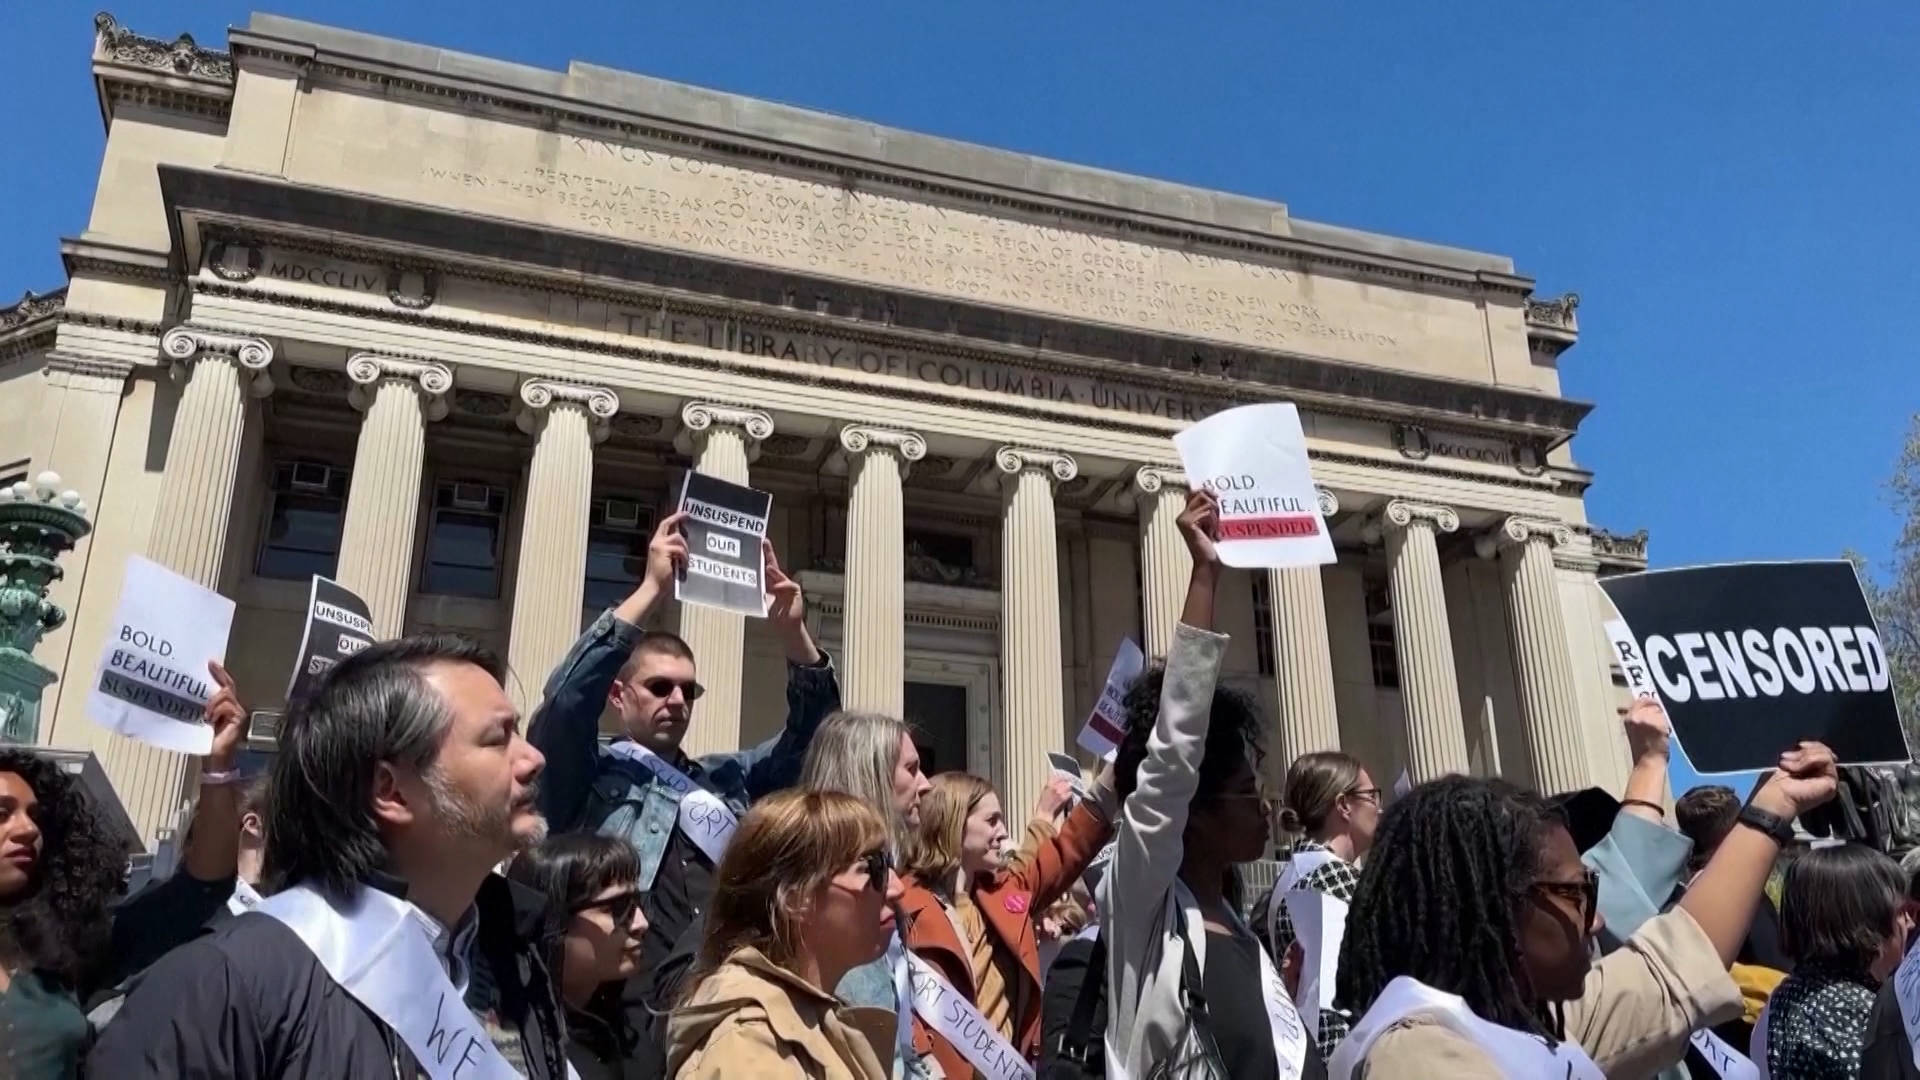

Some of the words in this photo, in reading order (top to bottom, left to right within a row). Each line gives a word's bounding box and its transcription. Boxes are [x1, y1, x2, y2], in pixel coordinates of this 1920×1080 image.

[269, 260, 378, 292] MDCCLIV
[1081, 250, 1144, 275] GEORGE
[1278, 300, 1321, 322] YORK
[619, 310, 685, 344] THE
[706, 325, 842, 367] LIBRARY
[858, 349, 900, 377] OF
[917, 359, 1075, 402] COLUMBIA
[1090, 385, 1212, 423] UNIVERS
[683, 501, 764, 532] UNSUSPEND
[1220, 497, 1311, 515] EAUTIFUL.
[707, 536, 736, 554] OUR
[688, 558, 758, 585] STUDENTS
[119, 624, 175, 660] BOLD.
[1645, 626, 1889, 703] CENSORED
